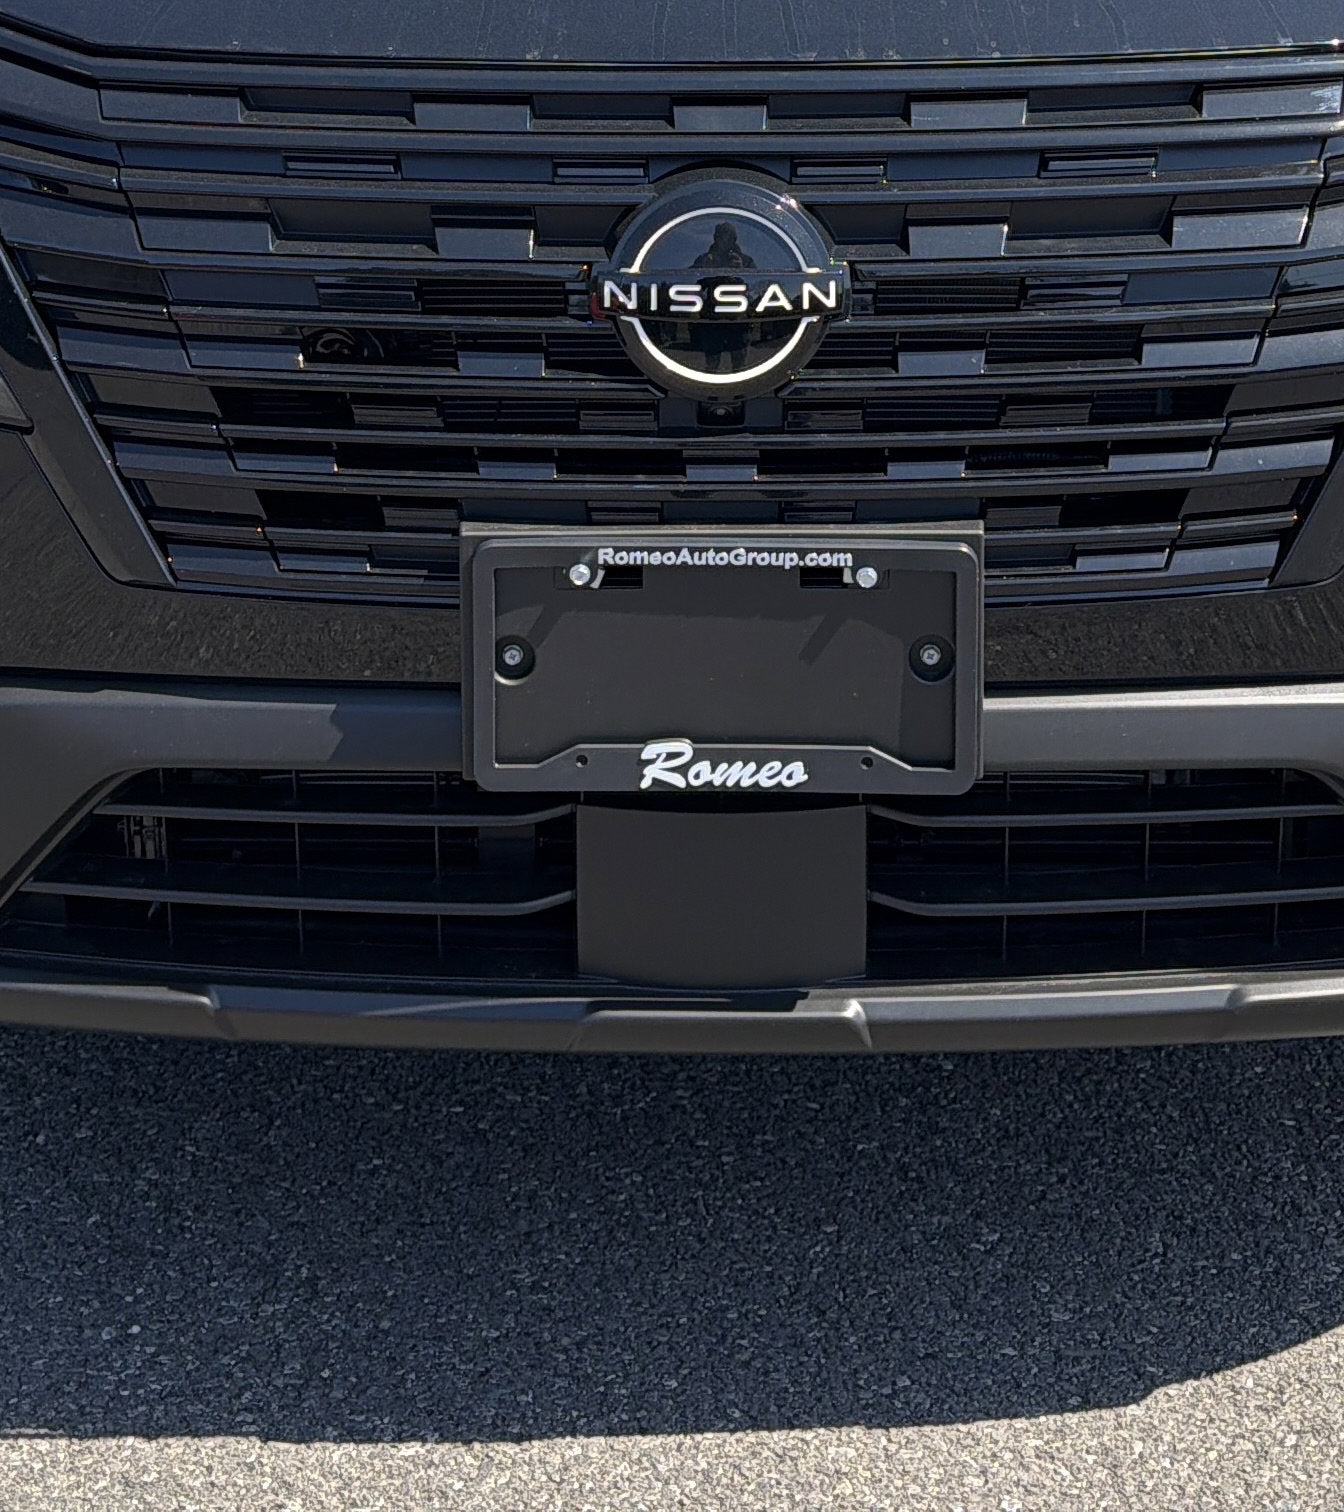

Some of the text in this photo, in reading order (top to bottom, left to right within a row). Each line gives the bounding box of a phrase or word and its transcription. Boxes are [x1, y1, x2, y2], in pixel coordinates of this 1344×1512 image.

[603, 281, 836, 313] NISSAN
[598, 547, 854, 569] RomeoAutoGroup.com
[639, 743, 809, 789] Romeo
